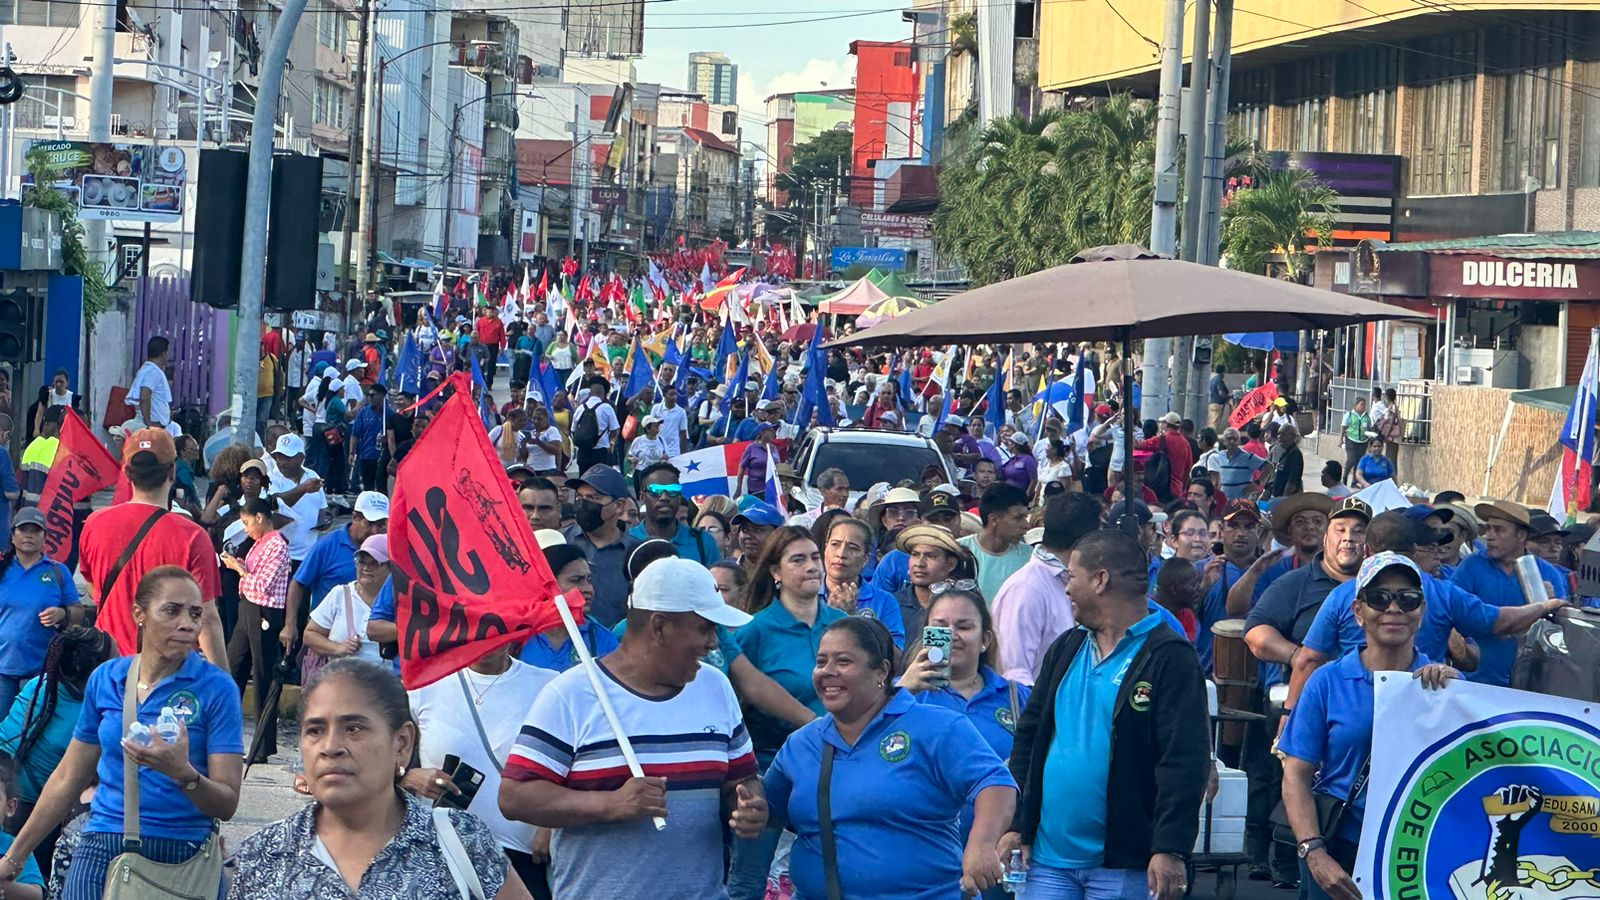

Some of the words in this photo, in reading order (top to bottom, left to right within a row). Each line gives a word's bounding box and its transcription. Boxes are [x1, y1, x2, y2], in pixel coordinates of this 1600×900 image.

[861, 213, 899, 222] CELULARES
[1462, 261, 1578, 288] DULCERIA
[1543, 798, 1597, 816] EDU.SAM
[1402, 798, 1432, 839] DE
[1561, 821, 1598, 832] 2000
